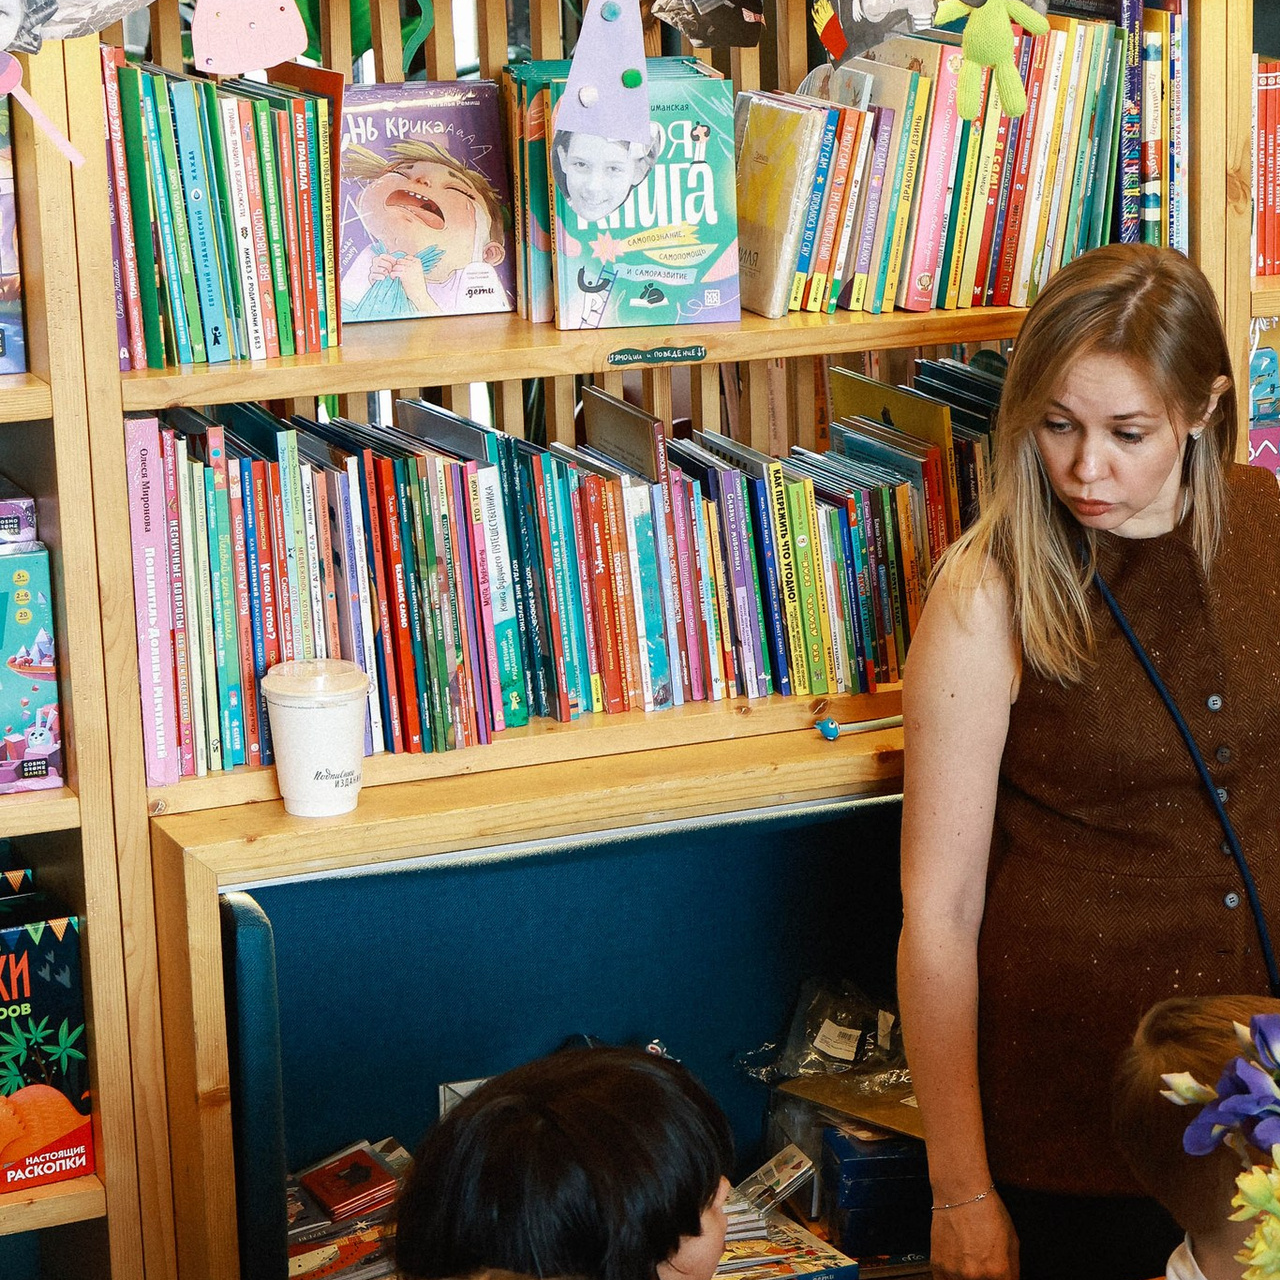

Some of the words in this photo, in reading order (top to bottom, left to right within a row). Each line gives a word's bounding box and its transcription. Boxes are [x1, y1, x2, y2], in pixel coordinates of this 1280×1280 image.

[296, 114, 306, 139] МОИ
[822, 131, 834, 152] МОГУ
[840, 132, 852, 152] МОГУ
[878, 132, 889, 152] МОГУ
[188, 151, 198, 181] ЖАЖДА
[297, 142, 308, 190] ПРАВИЛА
[819, 154, 830, 168] САМ
[838, 154, 849, 169] САМ
[876, 155, 886, 169] САМ
[903, 149, 918, 202] ДРАКОНЧИК
[911, 115, 923, 146] ДЗИНЬ
[830, 192, 841, 200] ЕМ
[806, 191, 821, 228] ГОТОВЛЮСЬ
[864, 202, 877, 234] ОБИЖАЮСЬ
[195, 210, 209, 268] РУДАШЕВСКИЙ
[627, 231, 686, 247] САМОПОЗНАНИЕ,
[804, 231, 814, 239] КО
[820, 203, 839, 259] САМОСТОЯТЕЛЬНО
[658, 248, 706, 260] САМОПОМОЩЬ
[801, 241, 812, 256] СНУ
[860, 242, 872, 265] ДЕЛЮСЬ
[635, 270, 688, 280] САМОРАЗВИТИЕ
[203, 272, 214, 307] ЕВГЕНИЙ
[140, 448, 151, 478] Олеся
[471, 476, 479, 501] ТАКОЙ?
[546, 474, 554, 499] МАРИНА
[773, 469, 784, 487] КАК
[141, 481, 153, 532] Миронова
[256, 480, 266, 509] Виктория
[548, 501, 557, 534] БАБУРИНА
[727, 494, 737, 521] Сказки
[775, 491, 790, 538] ПЕРЕЖИТЬ
[855, 504, 864, 519] Елена
[234, 515, 245, 551] Радость
[258, 512, 269, 549] Шиманская
[857, 521, 866, 539] Ульева
[874, 519, 882, 536] Елена
[168, 520, 182, 578] НЕСКУЧНЫЕ
[731, 531, 741, 571] животных
[780, 541, 792, 560] ЧТО
[875, 538, 884, 558] Ульева
[237, 562, 248, 591] Алиса
[261, 573, 273, 603] ШКОЛЕ
[395, 564, 405, 602] ВЕЖЛИВОЕ
[782, 562, 796, 603] УГОДНО!
[857, 572, 867, 596] ТАКСИ
[172, 582, 185, 629] ВОПРОСЫ
[239, 595, 249, 615] Киса
[398, 604, 407, 627] СЛОВО
[517, 602, 525, 631] ГРУСТНО
[263, 607, 276, 639] ГОТОВ?
[232, 727, 241, 750] CLEVER
[335, 774, 361, 788] ИЗДАНИ
[25, 1145, 86, 1165] НАСТОЯЩИЕ
[6, 1154, 87, 1184] РАСКОПКИ
